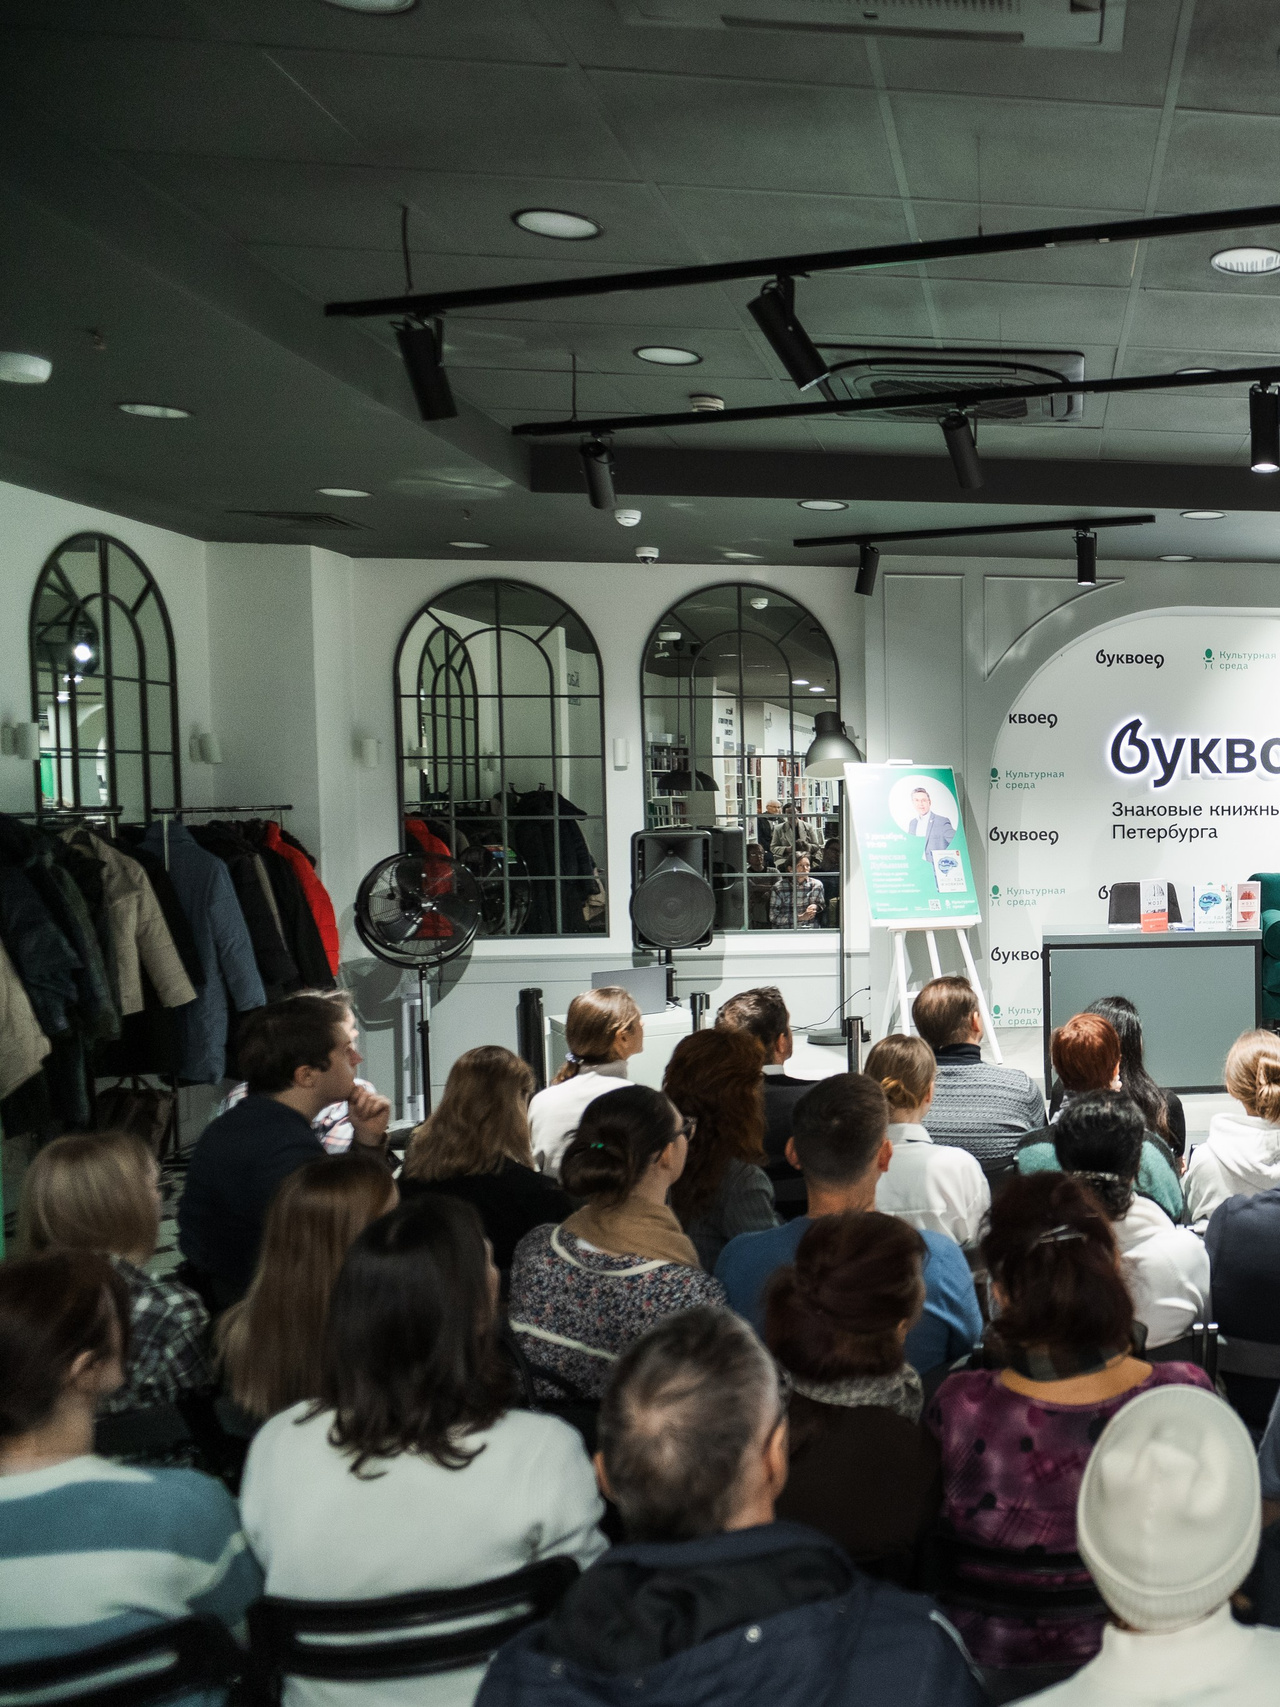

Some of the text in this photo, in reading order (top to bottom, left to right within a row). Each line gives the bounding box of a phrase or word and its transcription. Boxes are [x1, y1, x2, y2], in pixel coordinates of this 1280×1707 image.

[1096, 649, 1165, 669] буквоед
[1219, 651, 1277, 661] Культурная
[1219, 662, 1249, 672] среда
[1008, 713, 1058, 729] квоед
[1005, 770, 1065, 780] Культурная
[1005, 781, 1036, 791] среда
[1111, 801, 1203, 817] Знаковые
[989, 826, 1059, 846] буквоед
[1111, 823, 1218, 843] Петербурга
[1006, 887, 1066, 896] Культурная
[1006, 898, 1037, 908] среда
[990, 946, 1043, 965] букво
[1007, 1006, 1043, 1016] Культу
[1007, 1017, 1038, 1027] среда
